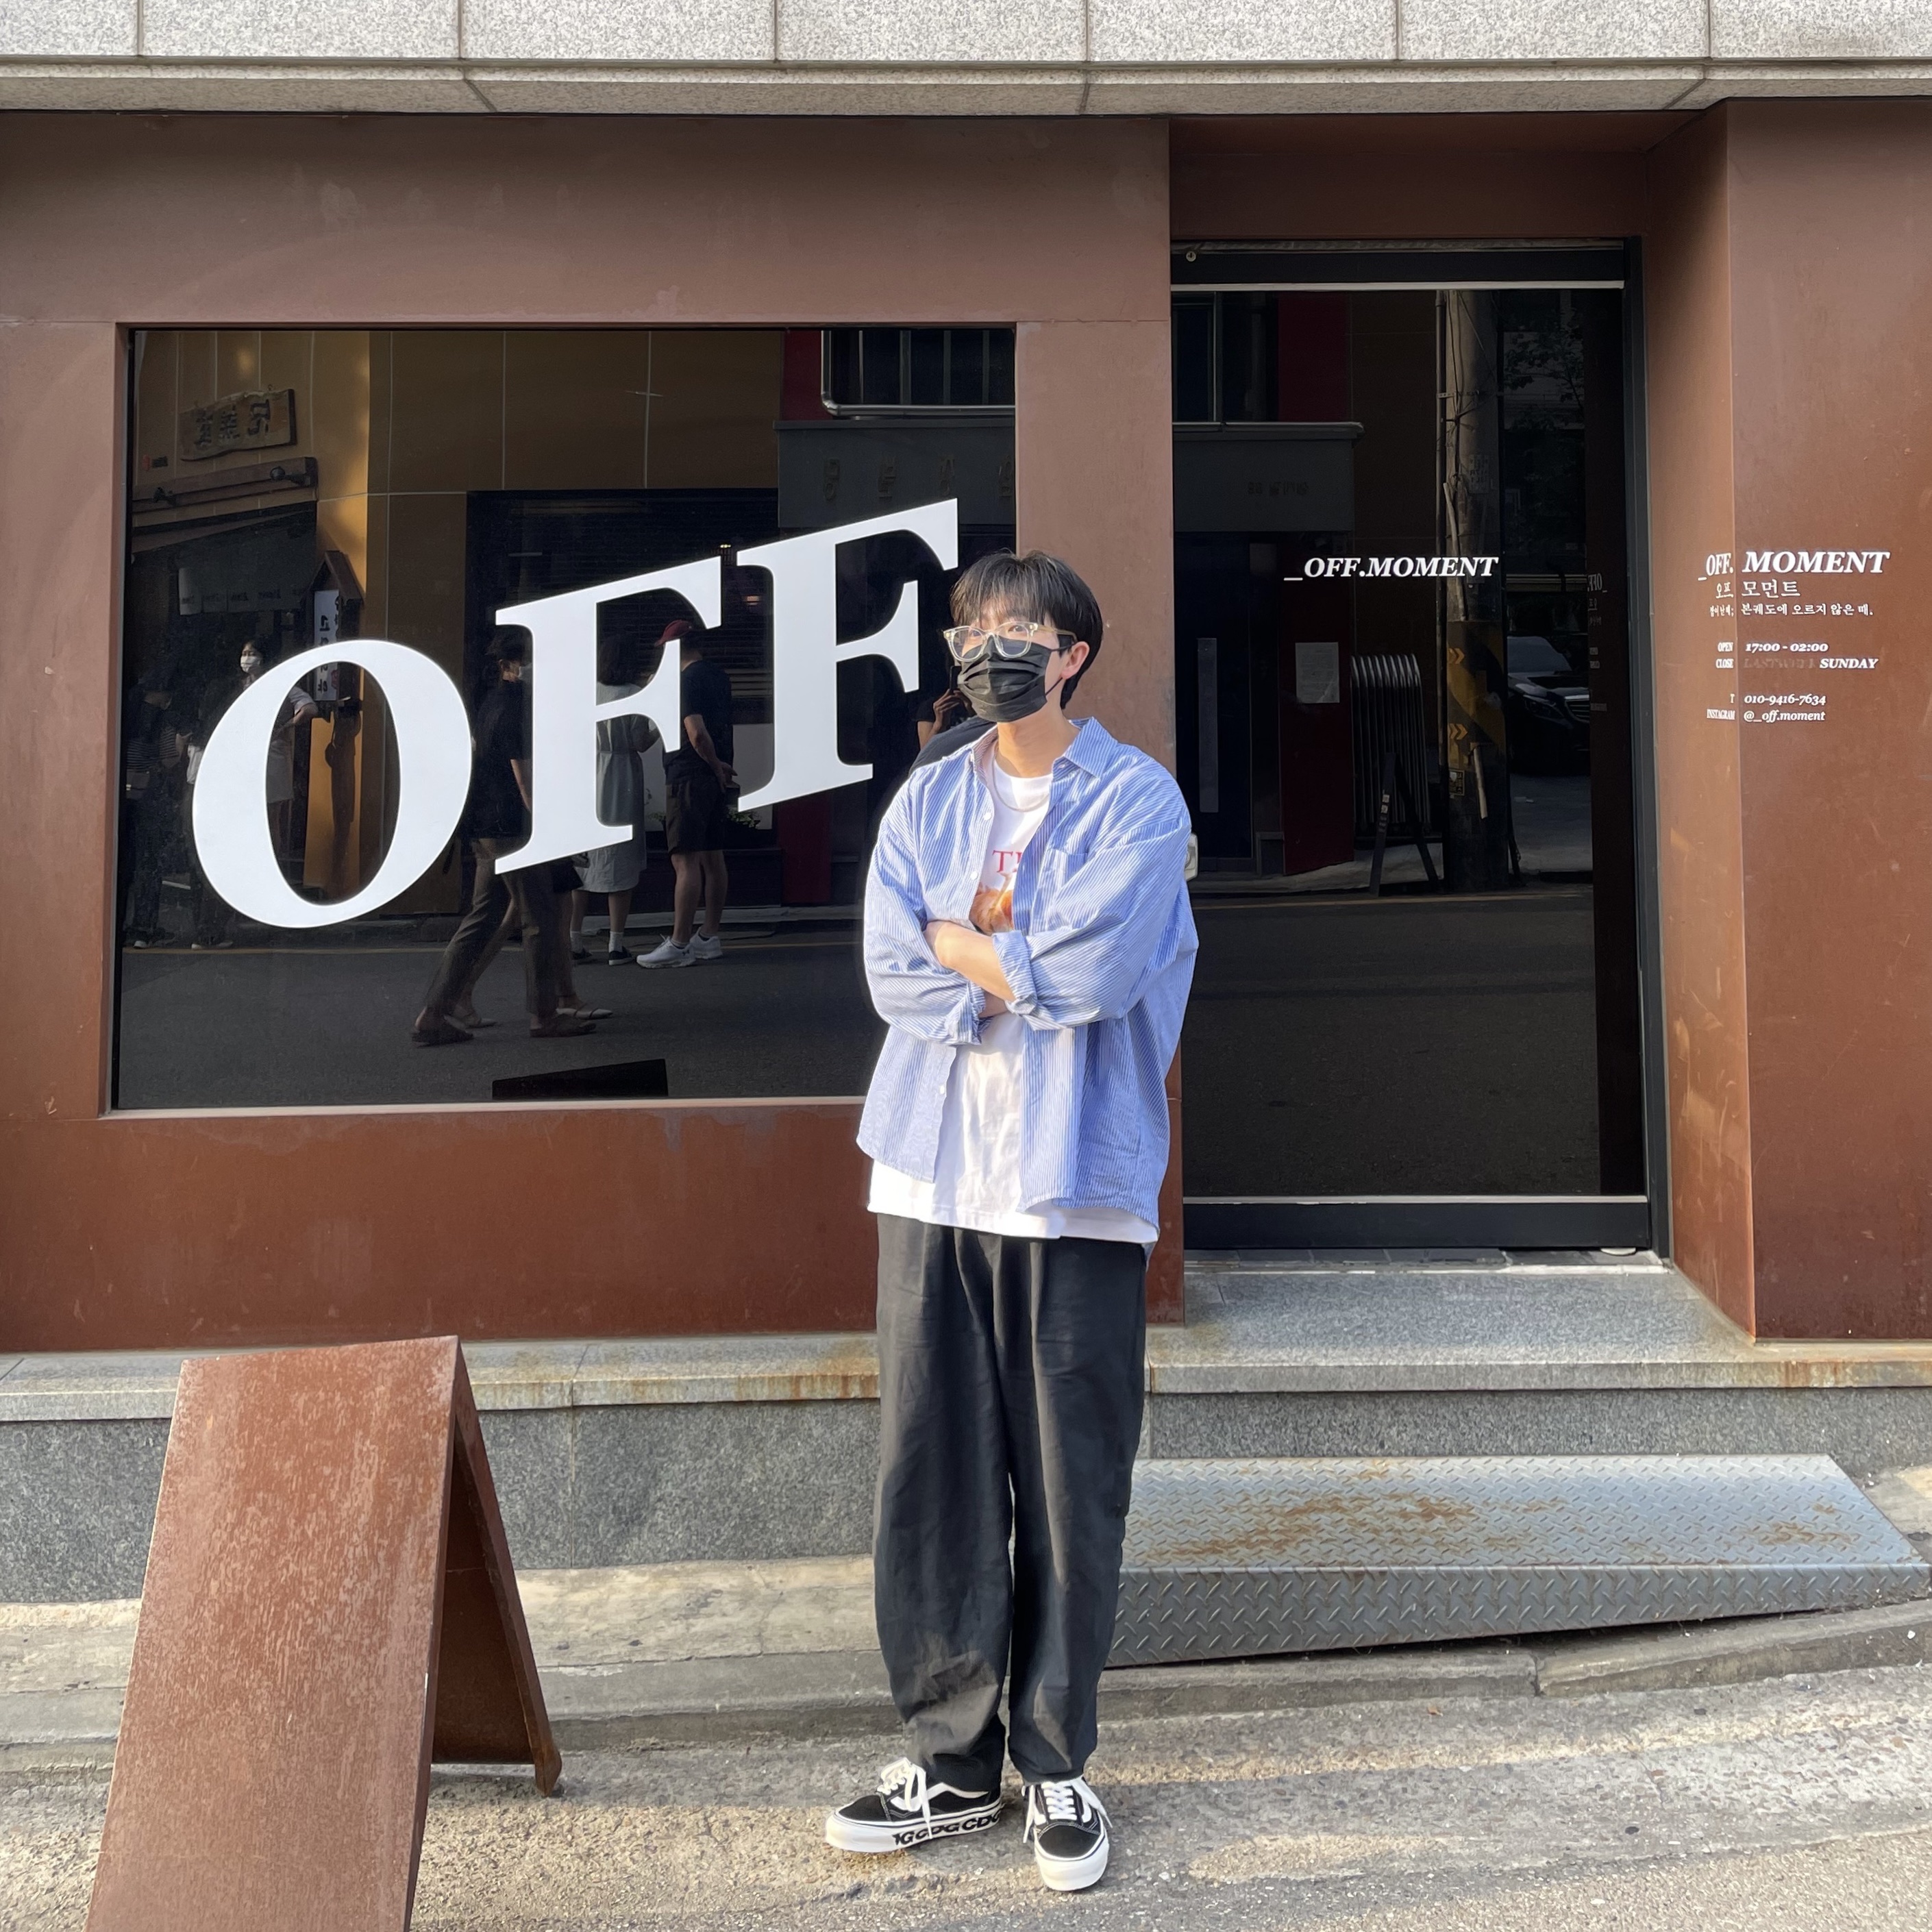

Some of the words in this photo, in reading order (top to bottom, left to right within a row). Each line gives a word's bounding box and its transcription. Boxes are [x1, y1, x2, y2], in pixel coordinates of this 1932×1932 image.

[1283, 556, 1500, 581] _OFF.MOMENT
[1741, 551, 1891, 573] MOMENT
[1716, 582, 1734, 599] 오프
[1741, 579, 1800, 598] 모먼트
[1741, 603, 1787, 616] 본궤도에
[1792, 603, 1826, 615] 오르지
[1830, 603, 1855, 615] 않은
[1857, 604, 1874, 616] 때.
[1718, 642, 1734, 652] OPEN
[1745, 643, 1781, 654] 17:00
[1789, 643, 1829, 652] 02:00
[1716, 658, 1734, 669] CLOSE
[1819, 658, 1879, 669] SUNDAY
[1744, 693, 1826, 706] 010-9416-7634
[192, 498, 958, 928] OFF
[1707, 708, 1735, 720] INSTAGRAM
[1743, 709, 1826, 723] @_off.moment
